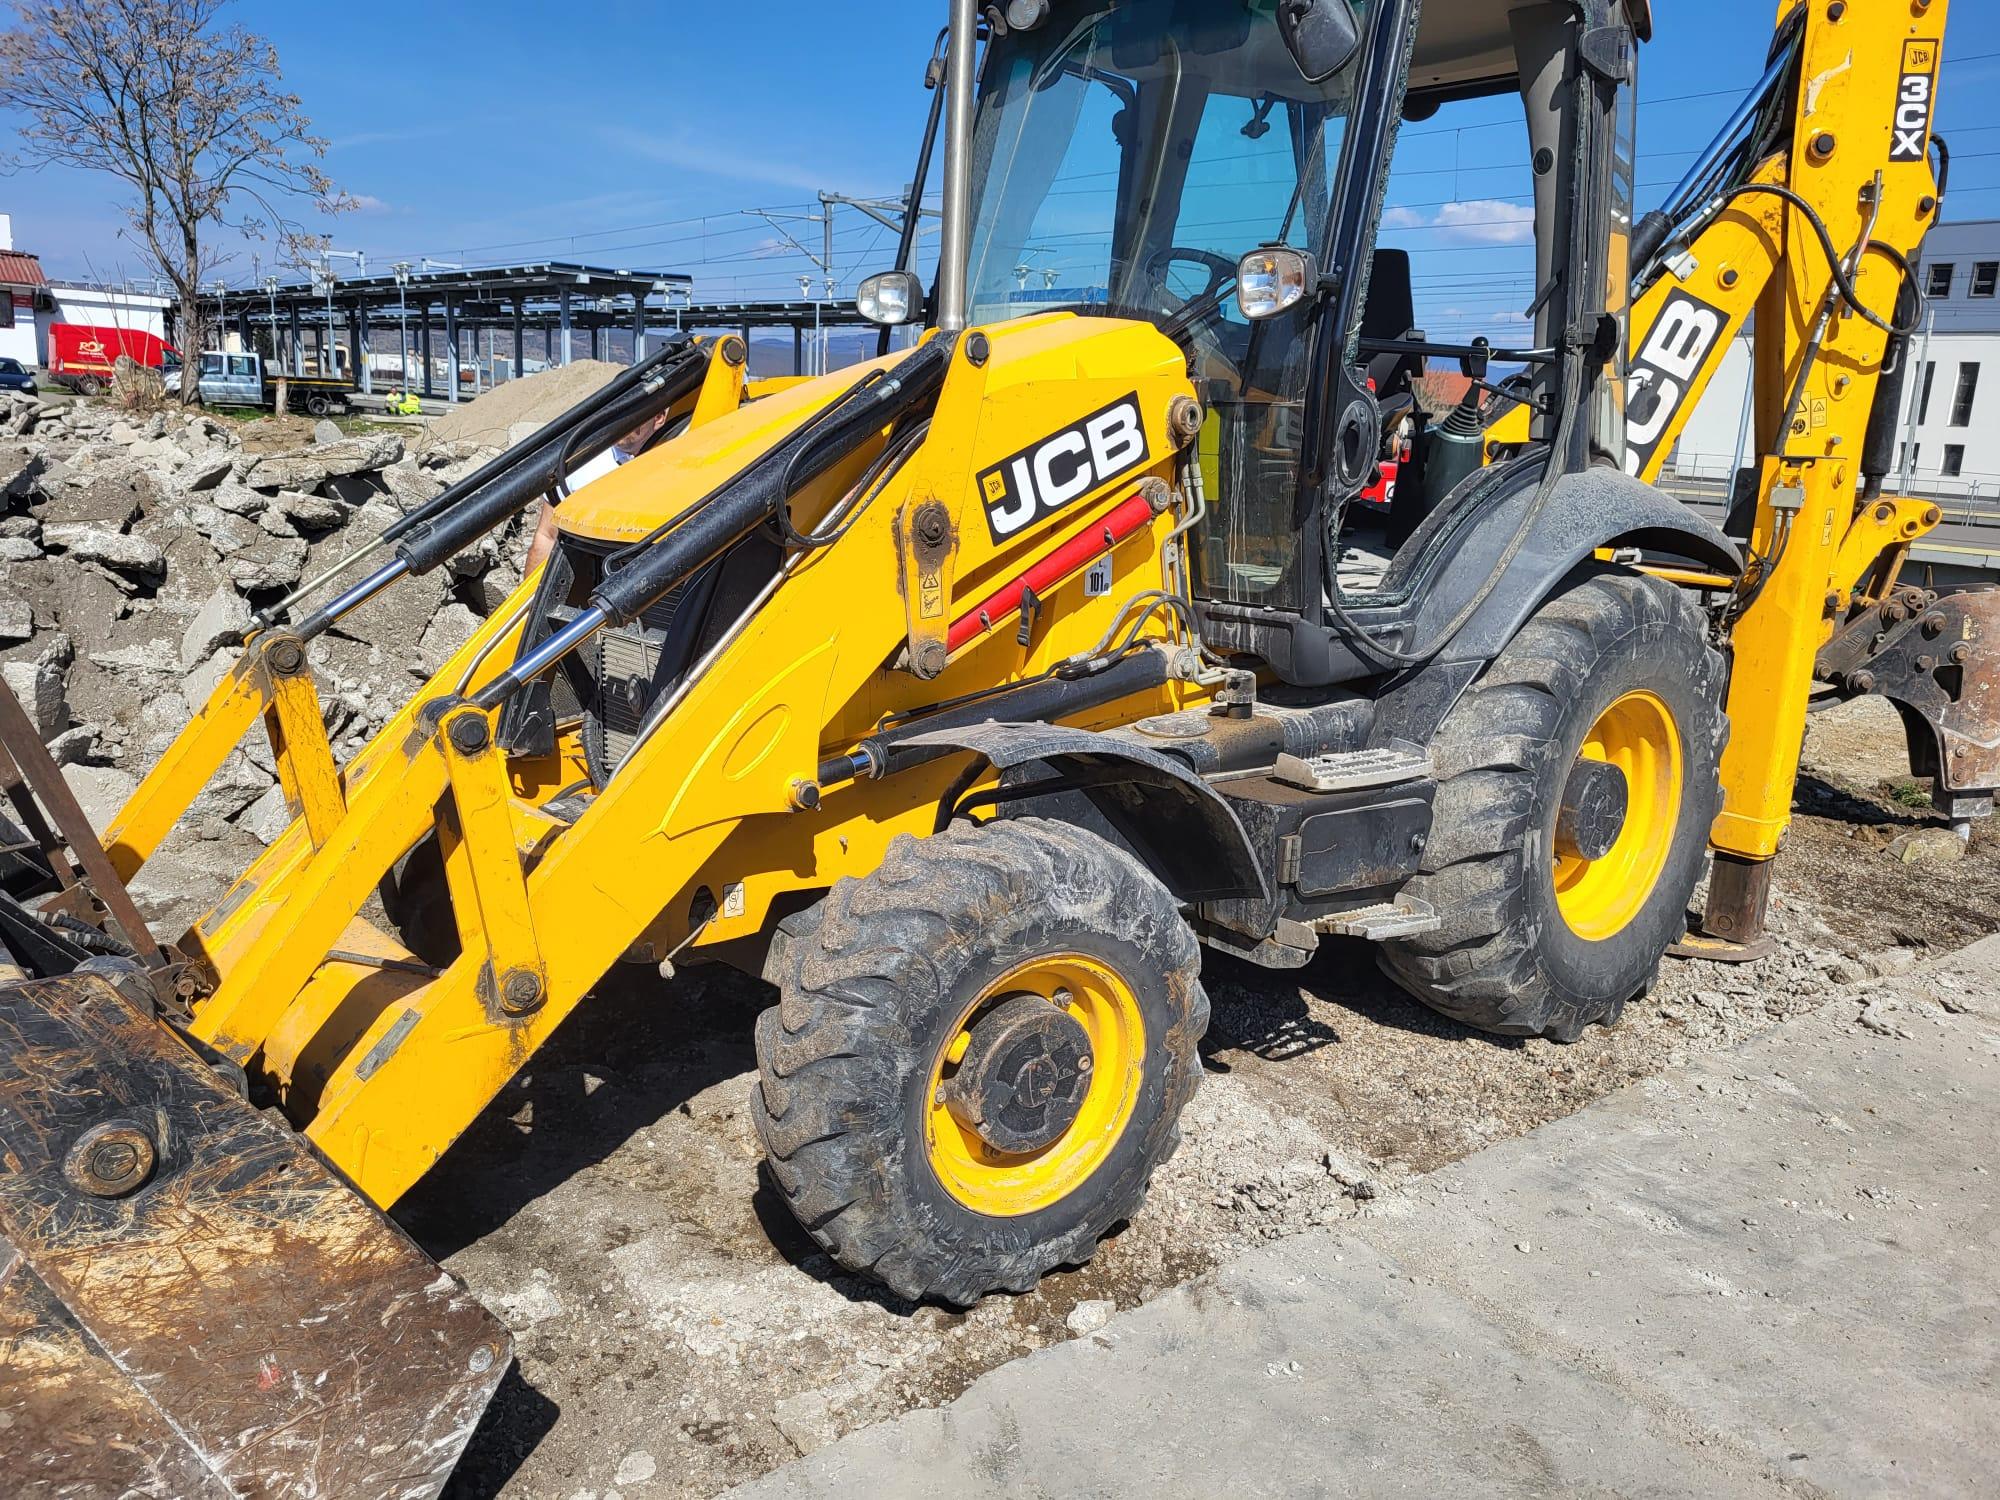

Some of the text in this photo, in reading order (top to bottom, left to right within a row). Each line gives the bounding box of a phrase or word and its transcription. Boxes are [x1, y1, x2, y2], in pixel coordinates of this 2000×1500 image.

[1911, 49, 1929, 65] JCB
[1891, 76, 1929, 155] 3CX
[1626, 300, 1718, 479] CB
[990, 404, 1144, 534] JCB
[1090, 572, 1104, 592] 101
